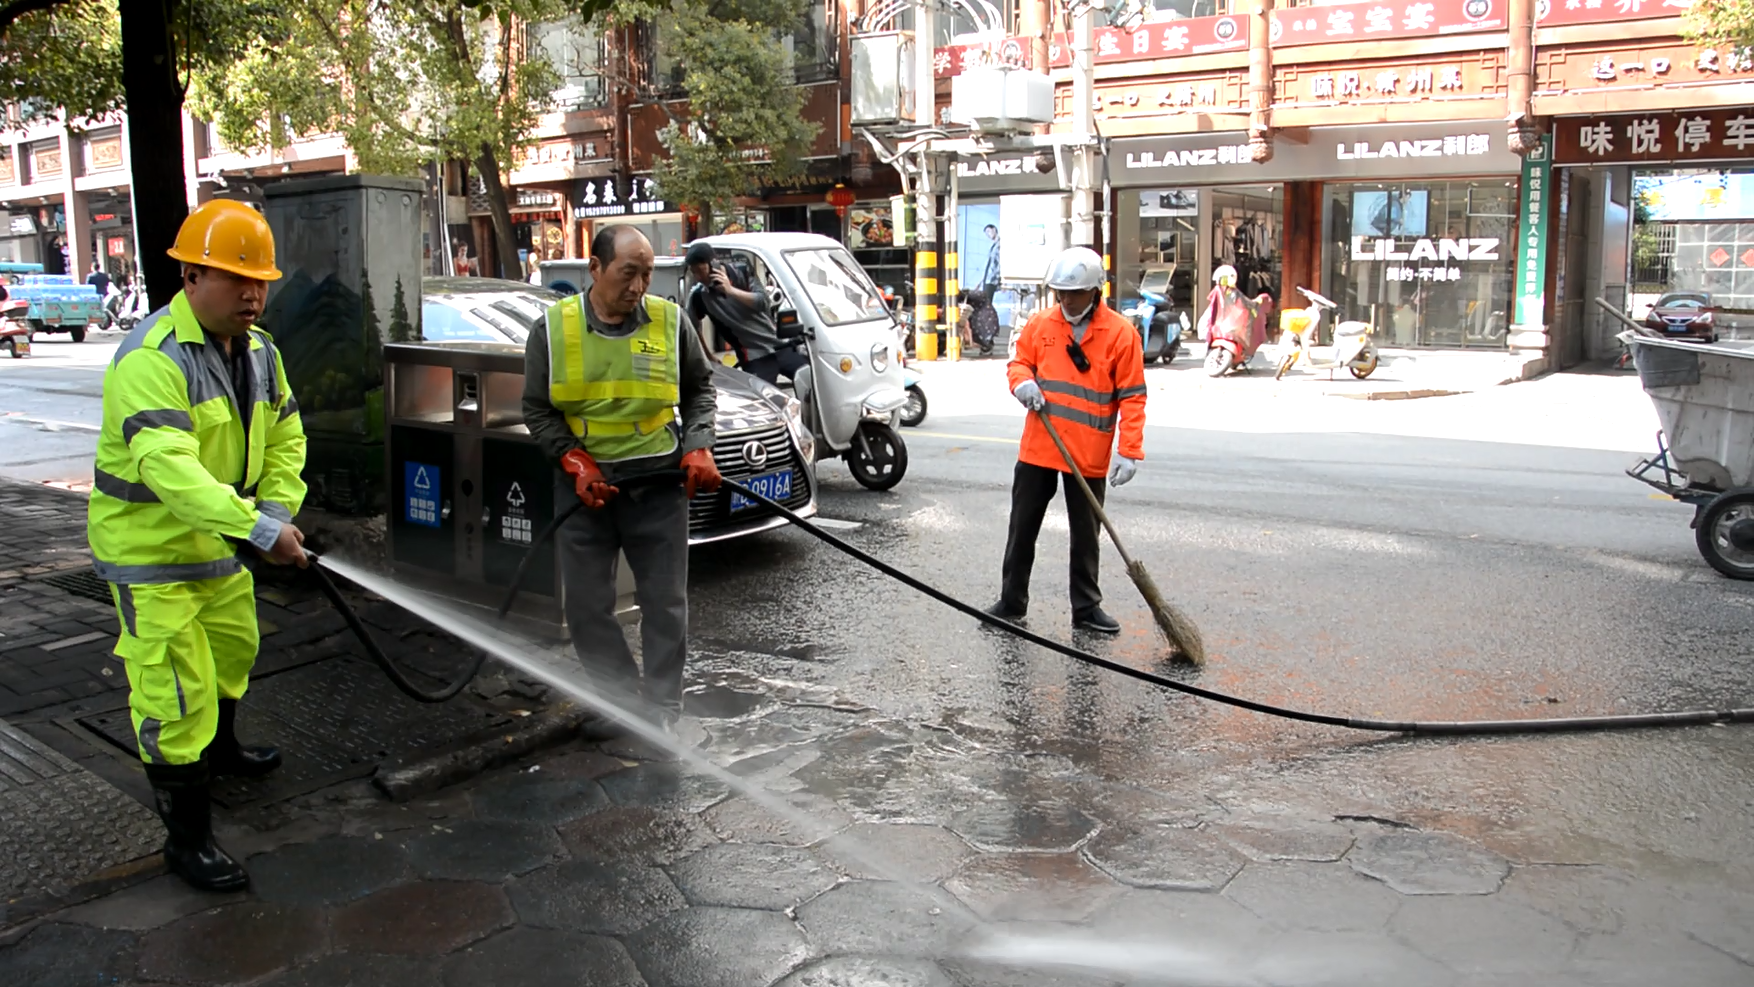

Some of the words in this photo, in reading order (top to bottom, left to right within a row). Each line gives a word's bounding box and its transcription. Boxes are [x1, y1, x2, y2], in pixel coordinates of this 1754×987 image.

[1325, 3, 1435, 36] 宝宝宴
[1098, 26, 1189, 56] 生日宴
[1580, 115, 1754, 155] 味悦停车
[1351, 238, 1499, 261] LILANZ
[1386, 267, 1460, 282] 简约·不简单
